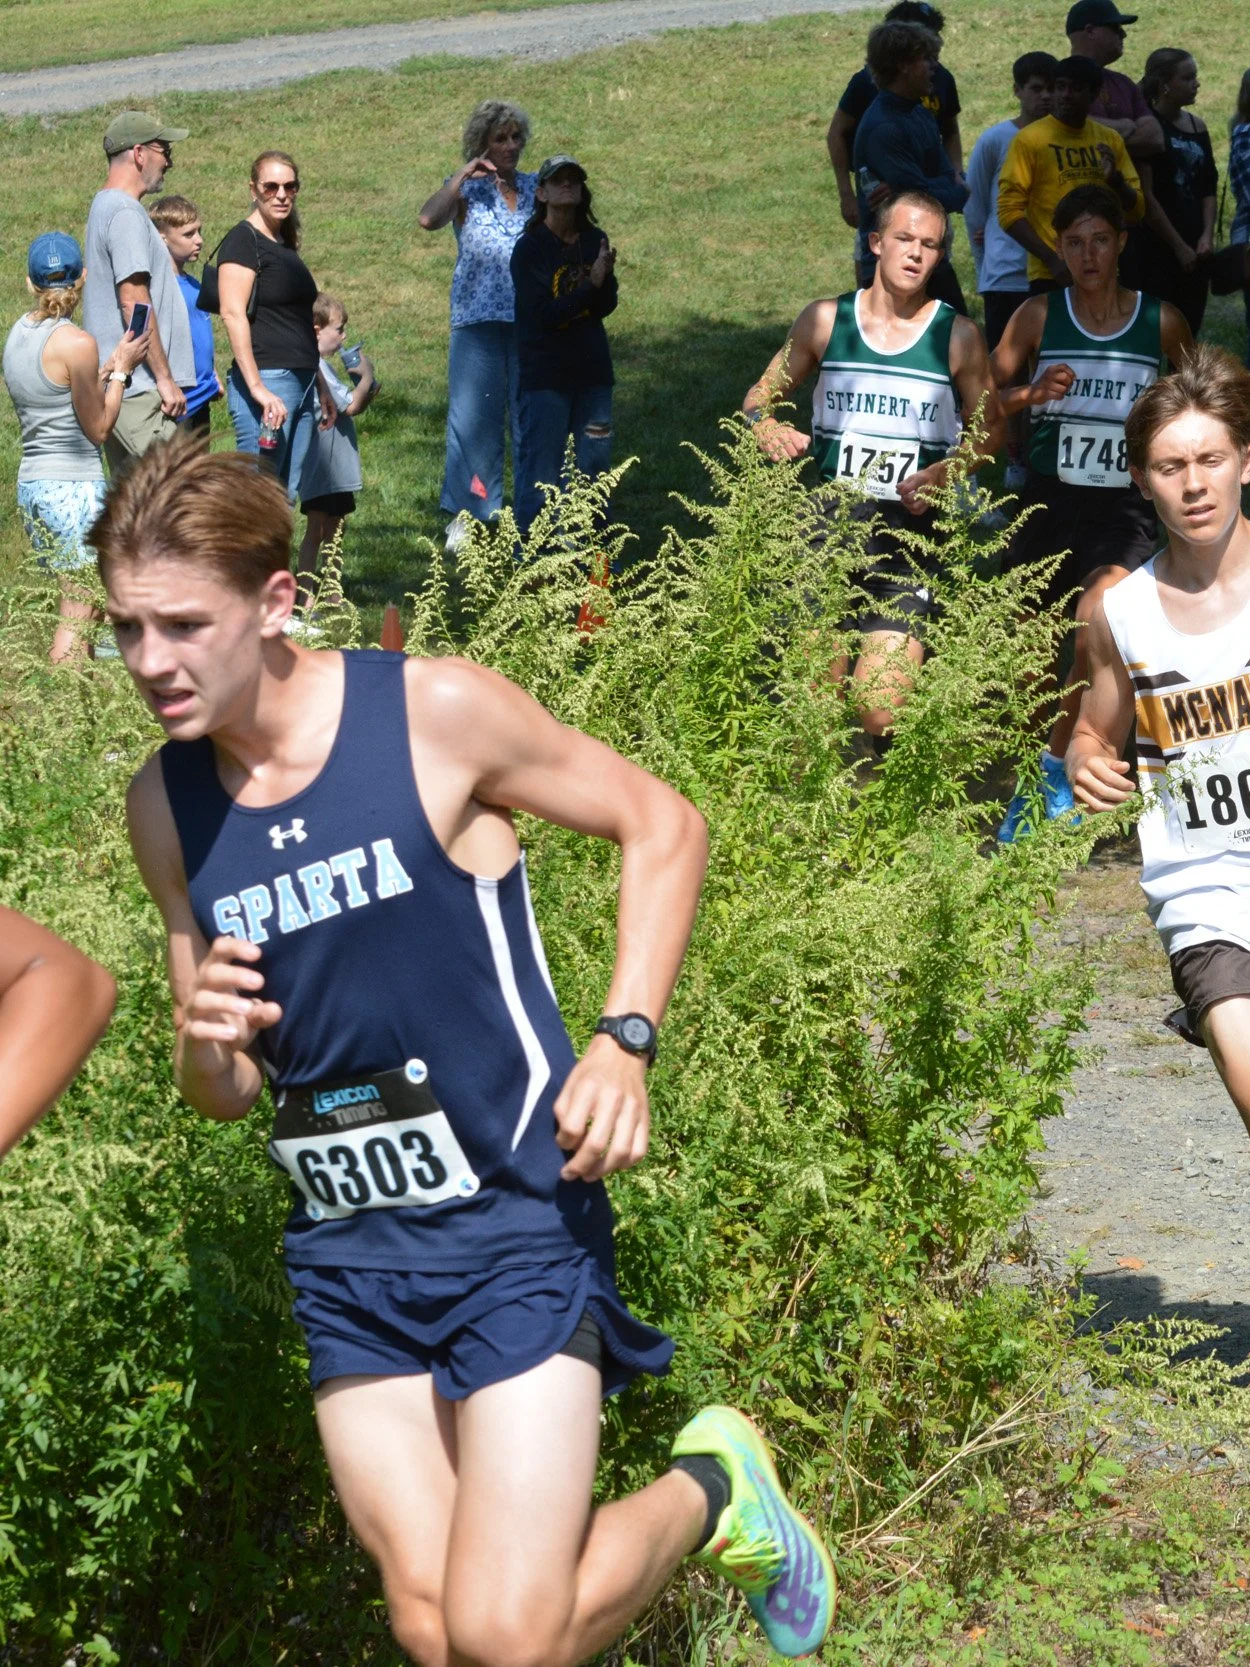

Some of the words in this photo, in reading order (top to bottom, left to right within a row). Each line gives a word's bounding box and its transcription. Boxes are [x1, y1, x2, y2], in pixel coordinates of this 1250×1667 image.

[1048, 143, 1100, 171] TCN
[826, 390, 911, 418] STEINERT
[918, 401, 939, 422] XC
[840, 444, 916, 484] 1757
[1061, 435, 1129, 473] 1748
[213, 837, 414, 945] SPARTA
[296, 1130, 447, 1207] 6303
